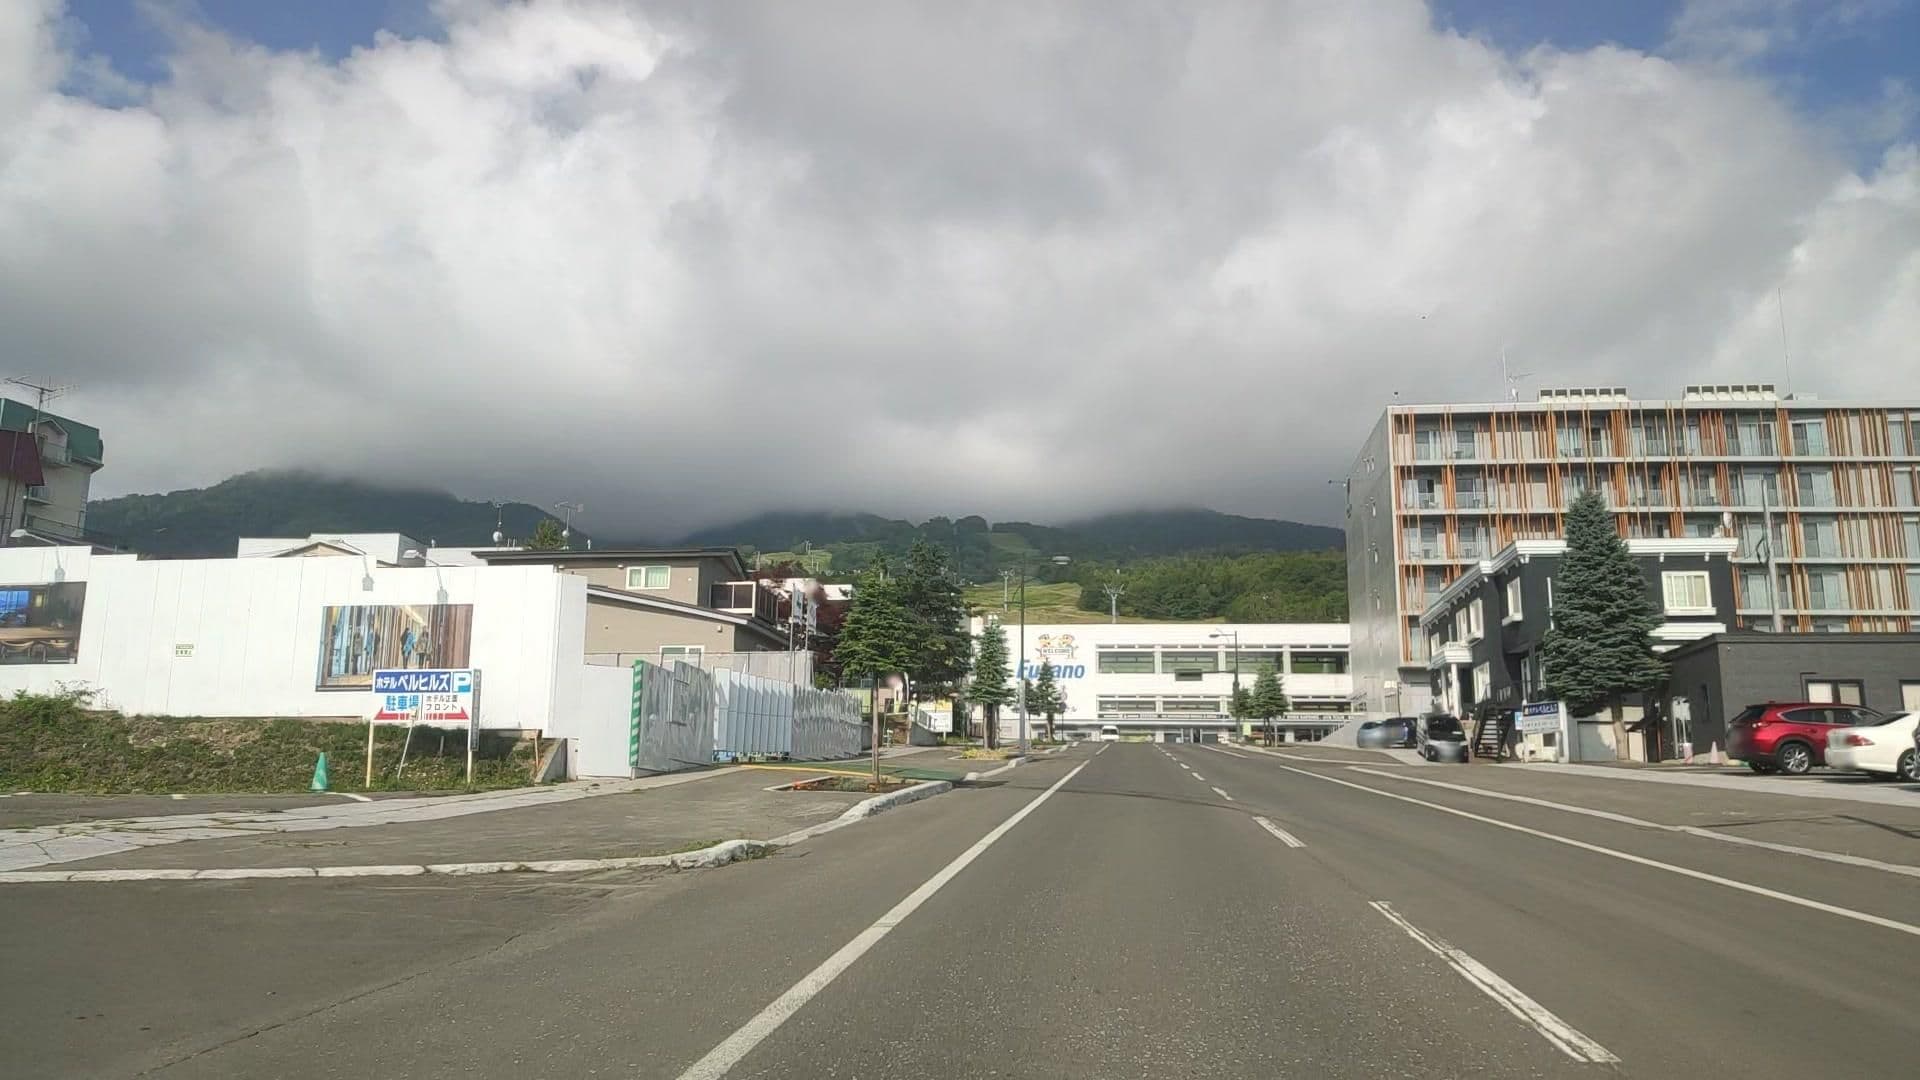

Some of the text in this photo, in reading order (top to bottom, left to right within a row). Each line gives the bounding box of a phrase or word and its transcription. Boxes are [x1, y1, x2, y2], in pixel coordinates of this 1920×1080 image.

[1016, 660, 1085, 679] Fuano
[376, 674, 449, 691] ホテルベルヒルズ
[426, 703, 457, 711] フロント
